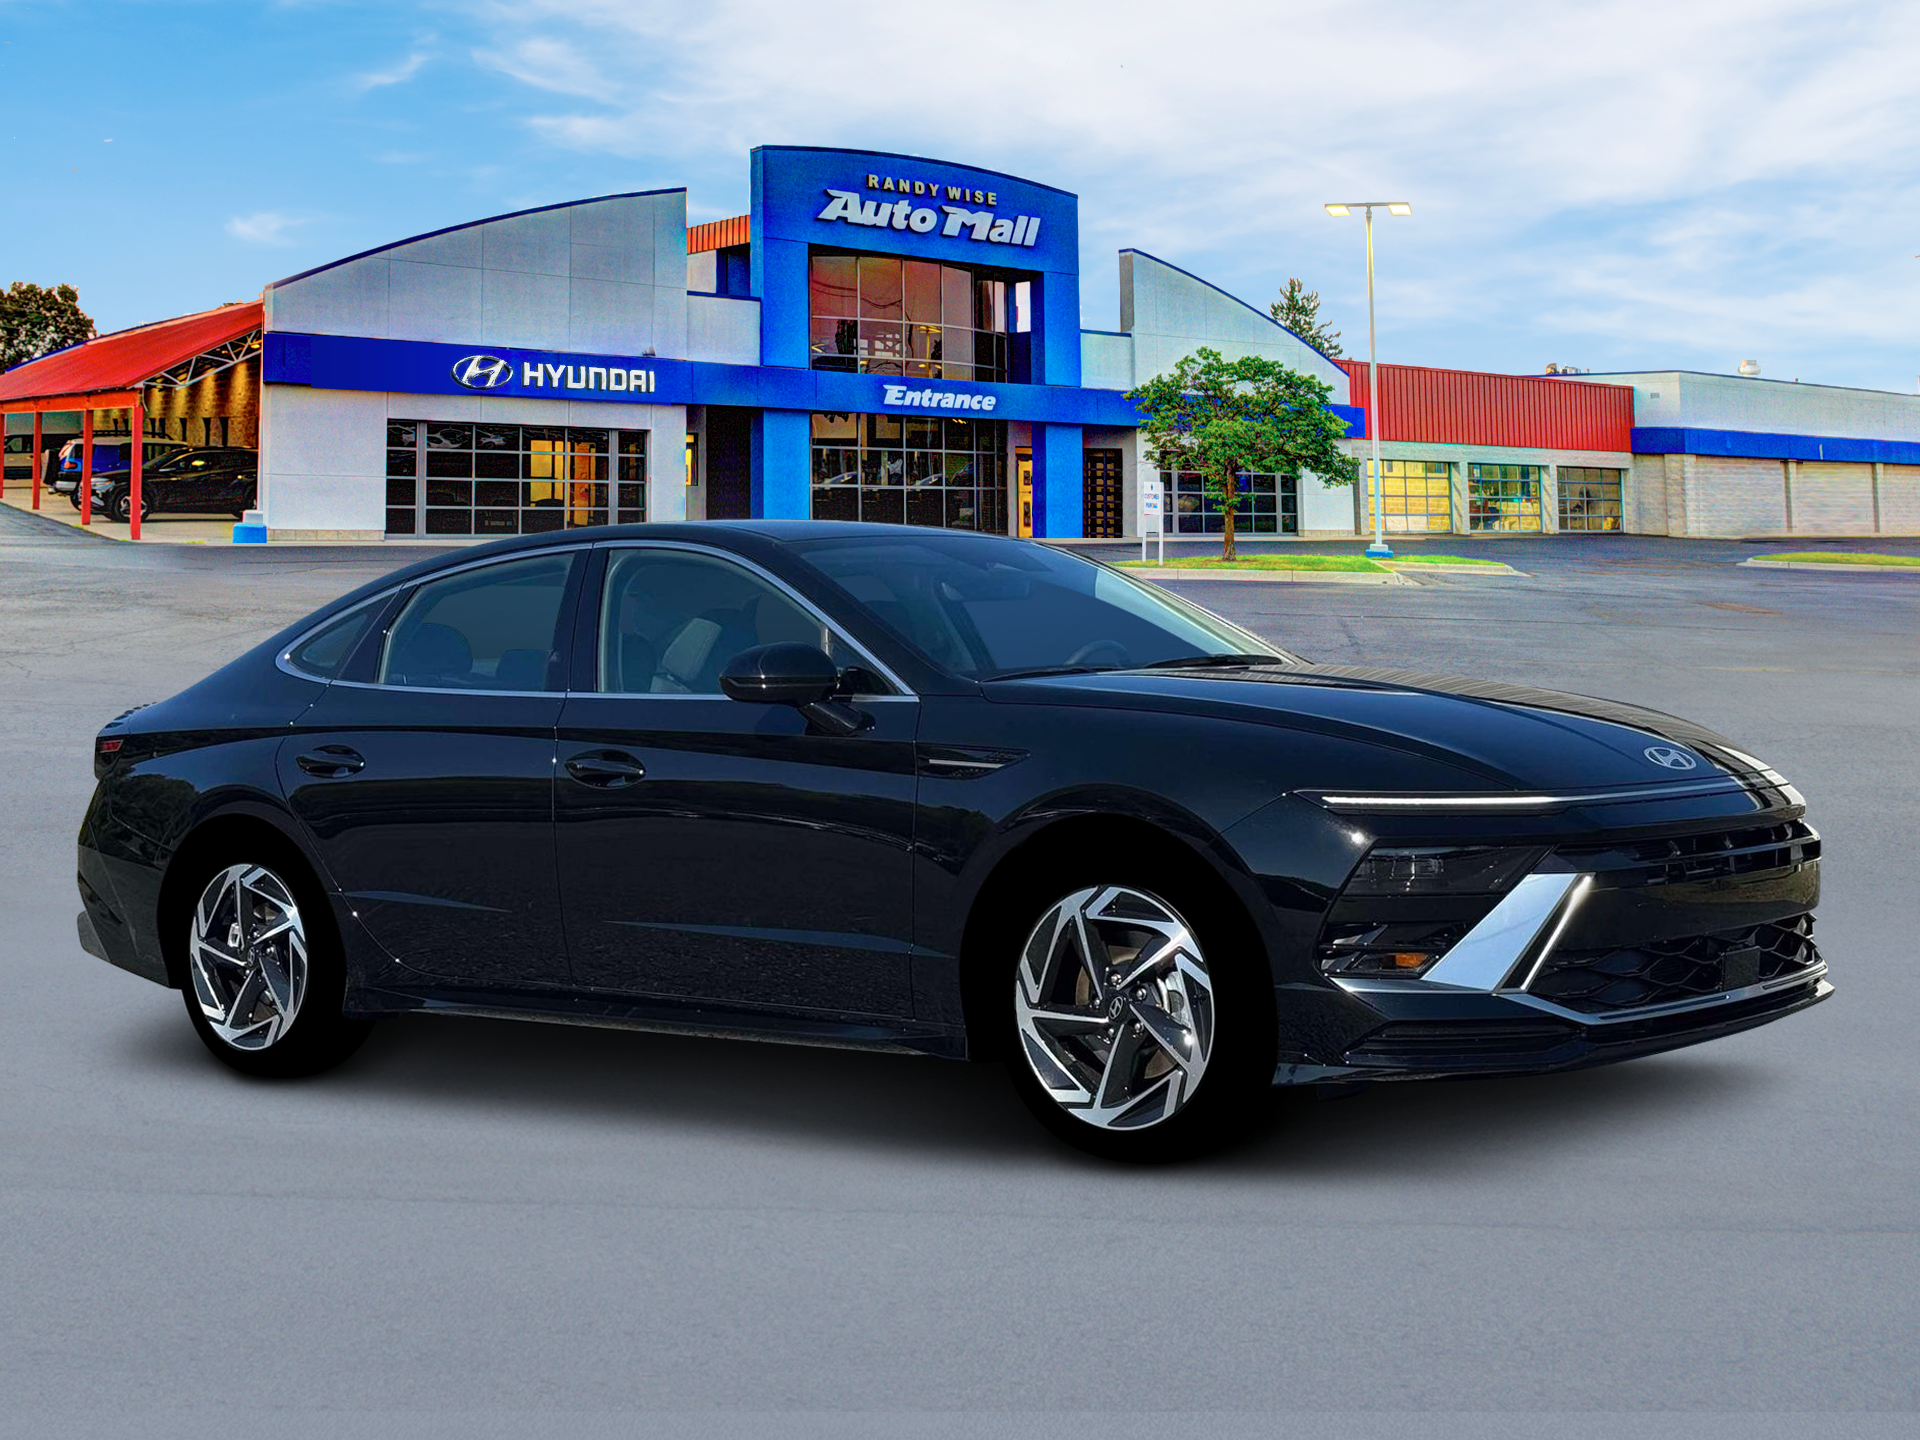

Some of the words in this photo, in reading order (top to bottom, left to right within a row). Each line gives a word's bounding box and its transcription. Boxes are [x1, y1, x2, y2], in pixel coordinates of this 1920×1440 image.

[866, 174, 939, 197] RANDY
[947, 187, 997, 205] WISE
[816, 188, 938, 233] Auto
[942, 205, 1041, 246] Mall
[523, 361, 656, 393] HYUNDAI
[883, 384, 996, 411] Entrance
